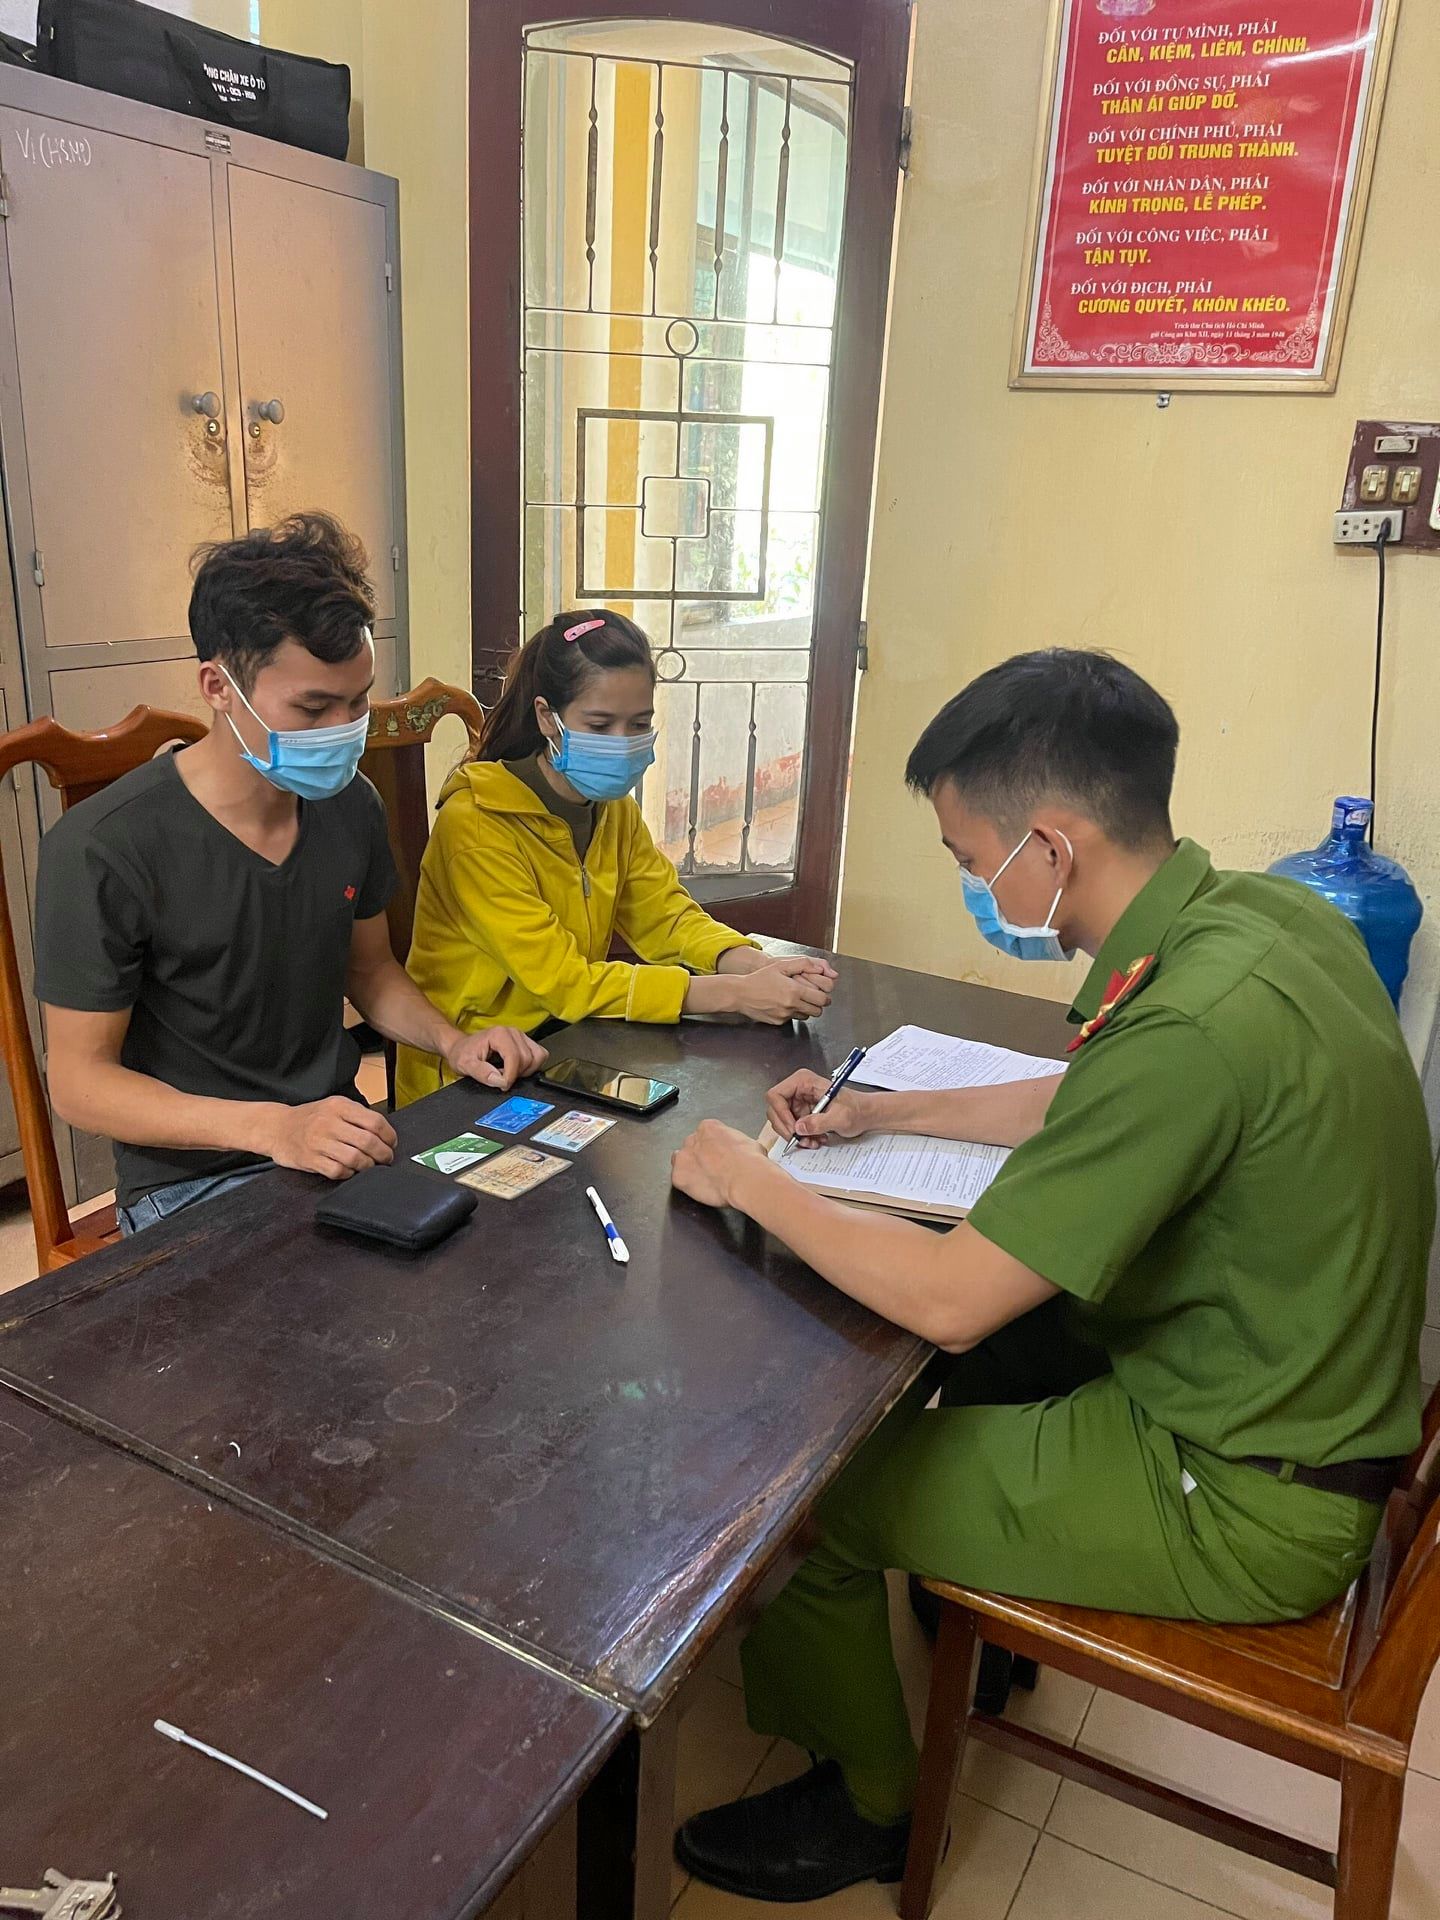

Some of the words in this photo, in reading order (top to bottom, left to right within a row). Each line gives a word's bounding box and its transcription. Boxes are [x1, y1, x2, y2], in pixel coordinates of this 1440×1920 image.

[1098, 26, 1126, 44] ĐỐI
[1131, 27, 1157, 42] VỚI
[1162, 28, 1184, 43] TỰ
[1186, 23, 1233, 39] MÌNH,
[1237, 20, 1277, 36] PHẢI
[1106, 42, 1144, 63] CẦN,
[1150, 42, 1195, 62] KIỆM,
[1201, 39, 1246, 58] LIÊM,
[1252, 35, 1310, 55] CHÍNH.
[240, 74, 249, 86] XE
[1093, 78, 1119, 96] ĐỐI
[1125, 79, 1151, 94] VỚI
[1155, 74, 1200, 92] ĐỒNG
[1203, 75, 1226, 90] SỰ,
[1231, 71, 1271, 88] PHẢI
[1101, 95, 1143, 115] THÂN
[1147, 94, 1164, 113] ÁI
[1168, 91, 1207, 111] GIÚP
[1210, 88, 1239, 110] ĐỠ.
[1088, 125, 1115, 144] ĐỐI
[1120, 127, 1146, 142] VỚI
[1150, 124, 1199, 141] CHÍNH
[1203, 120, 1239, 138] PHỦ,
[1243, 120, 1283, 137] PHẢI
[1097, 144, 1143, 165] TUYỆT
[1147, 141, 1174, 161] ĐỐI
[1179, 143, 1233, 159] TRUNG
[1238, 139, 1299, 158] THÀNH.
[1082, 176, 1109, 195] ĐỐI
[1113, 178, 1140, 192] VỚI
[1142, 175, 1186, 192] NHÂN
[1190, 175, 1226, 191] DÂN,
[1231, 173, 1270, 190] PHẢI
[1089, 196, 1127, 214] KÍNH
[1132, 196, 1189, 216] TRỌNG,
[1193, 190, 1213, 211] LỄ
[1217, 193, 1266, 211] PHÉP.
[1076, 226, 1102, 245] ĐỐI
[1106, 229, 1133, 243] VỚI
[1136, 227, 1180, 242] CÔNG
[1185, 226, 1225, 244] VIỆC,
[1228, 224, 1268, 241] PHẢI
[1084, 247, 1115, 267] TẬN
[1119, 247, 1151, 267] TỤY.
[1071, 277, 1097, 295] ĐỐI
[1101, 279, 1127, 294] VỚI
[1130, 280, 1172, 295] ĐỊCH,
[1176, 277, 1212, 293] PHẢI
[1078, 298, 1130, 313] CƯƠNG
[1135, 293, 1187, 315] QUYẾT,
[1192, 295, 1238, 312] KHÔN
[1242, 295, 1291, 312] KHÉO.
